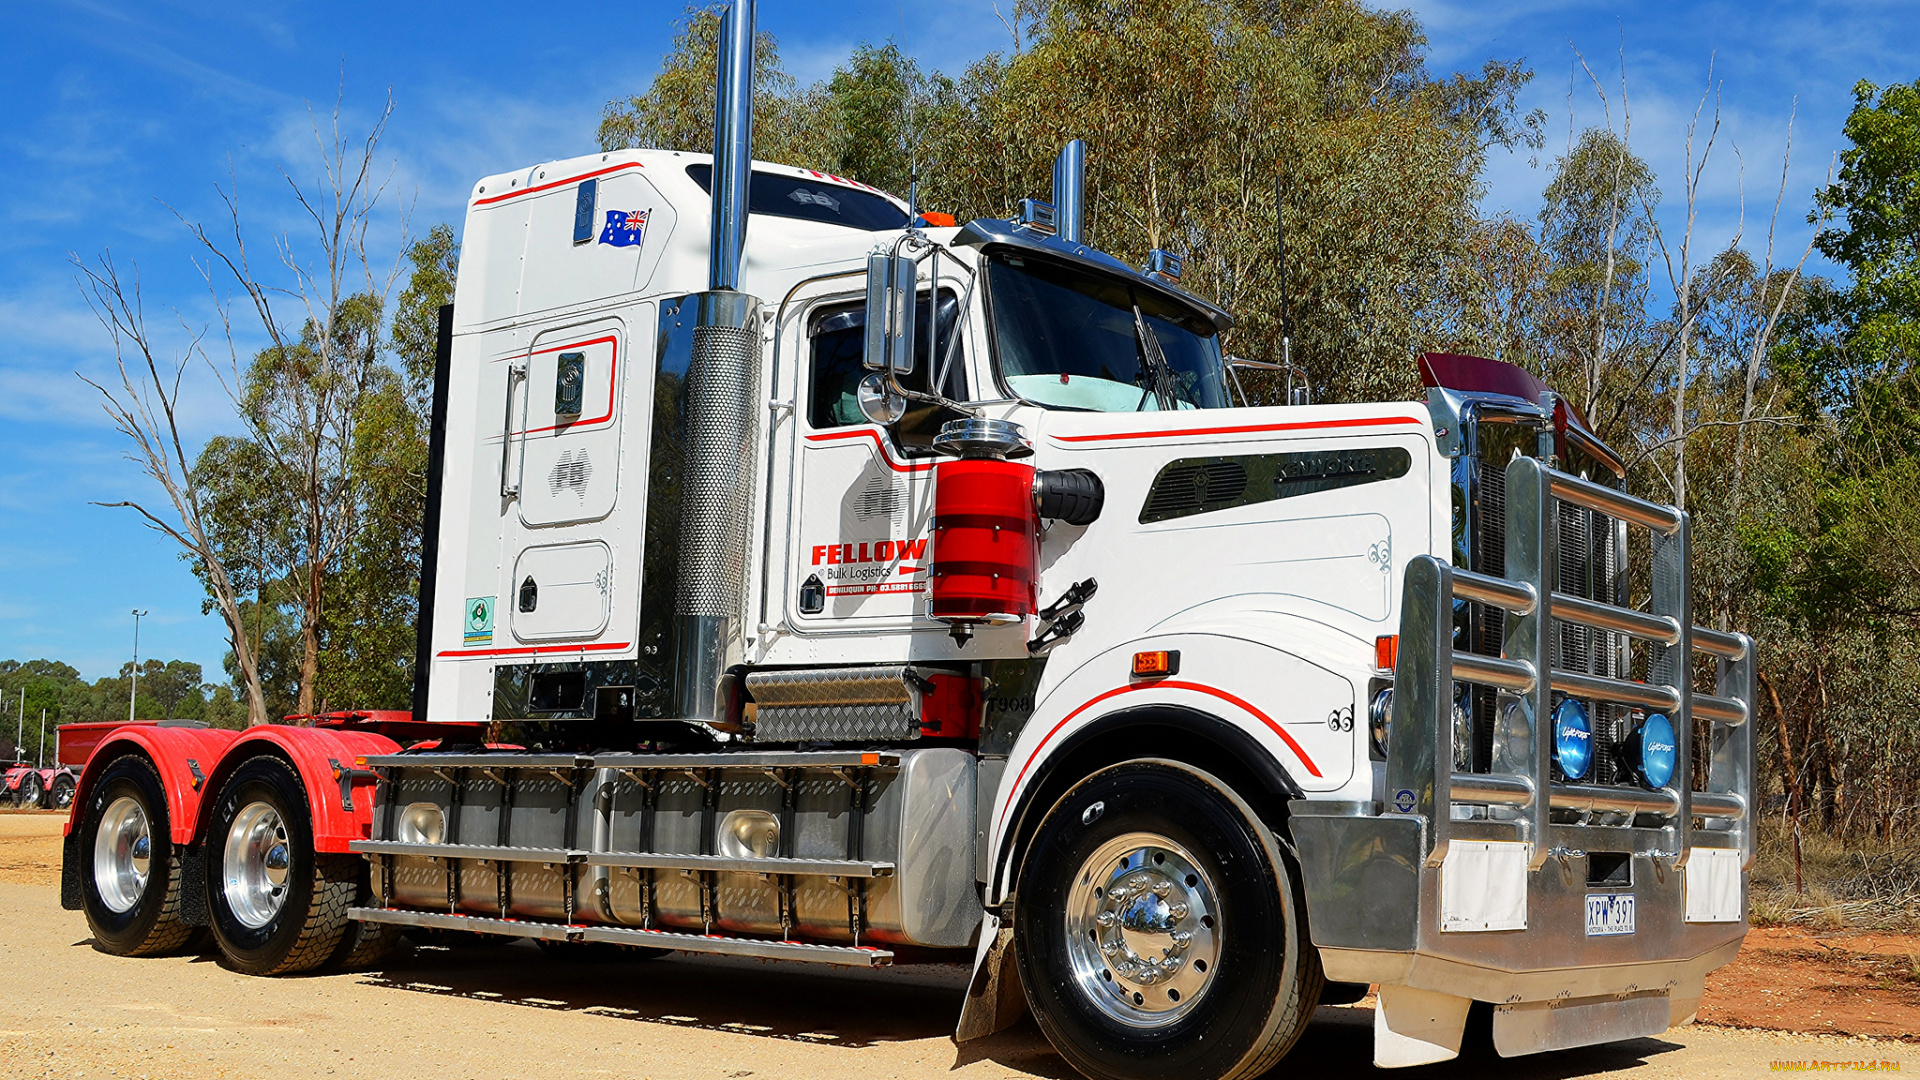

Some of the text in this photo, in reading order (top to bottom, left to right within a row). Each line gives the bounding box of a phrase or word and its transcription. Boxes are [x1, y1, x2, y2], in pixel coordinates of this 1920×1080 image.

[1276, 454, 1376, 478] KENWORTH
[812, 539, 929, 566] FELLOW
[827, 566, 891, 582] Bulk Logistics
[988, 697, 1030, 712] T908
[1588, 899, 1633, 926] XPW 397
